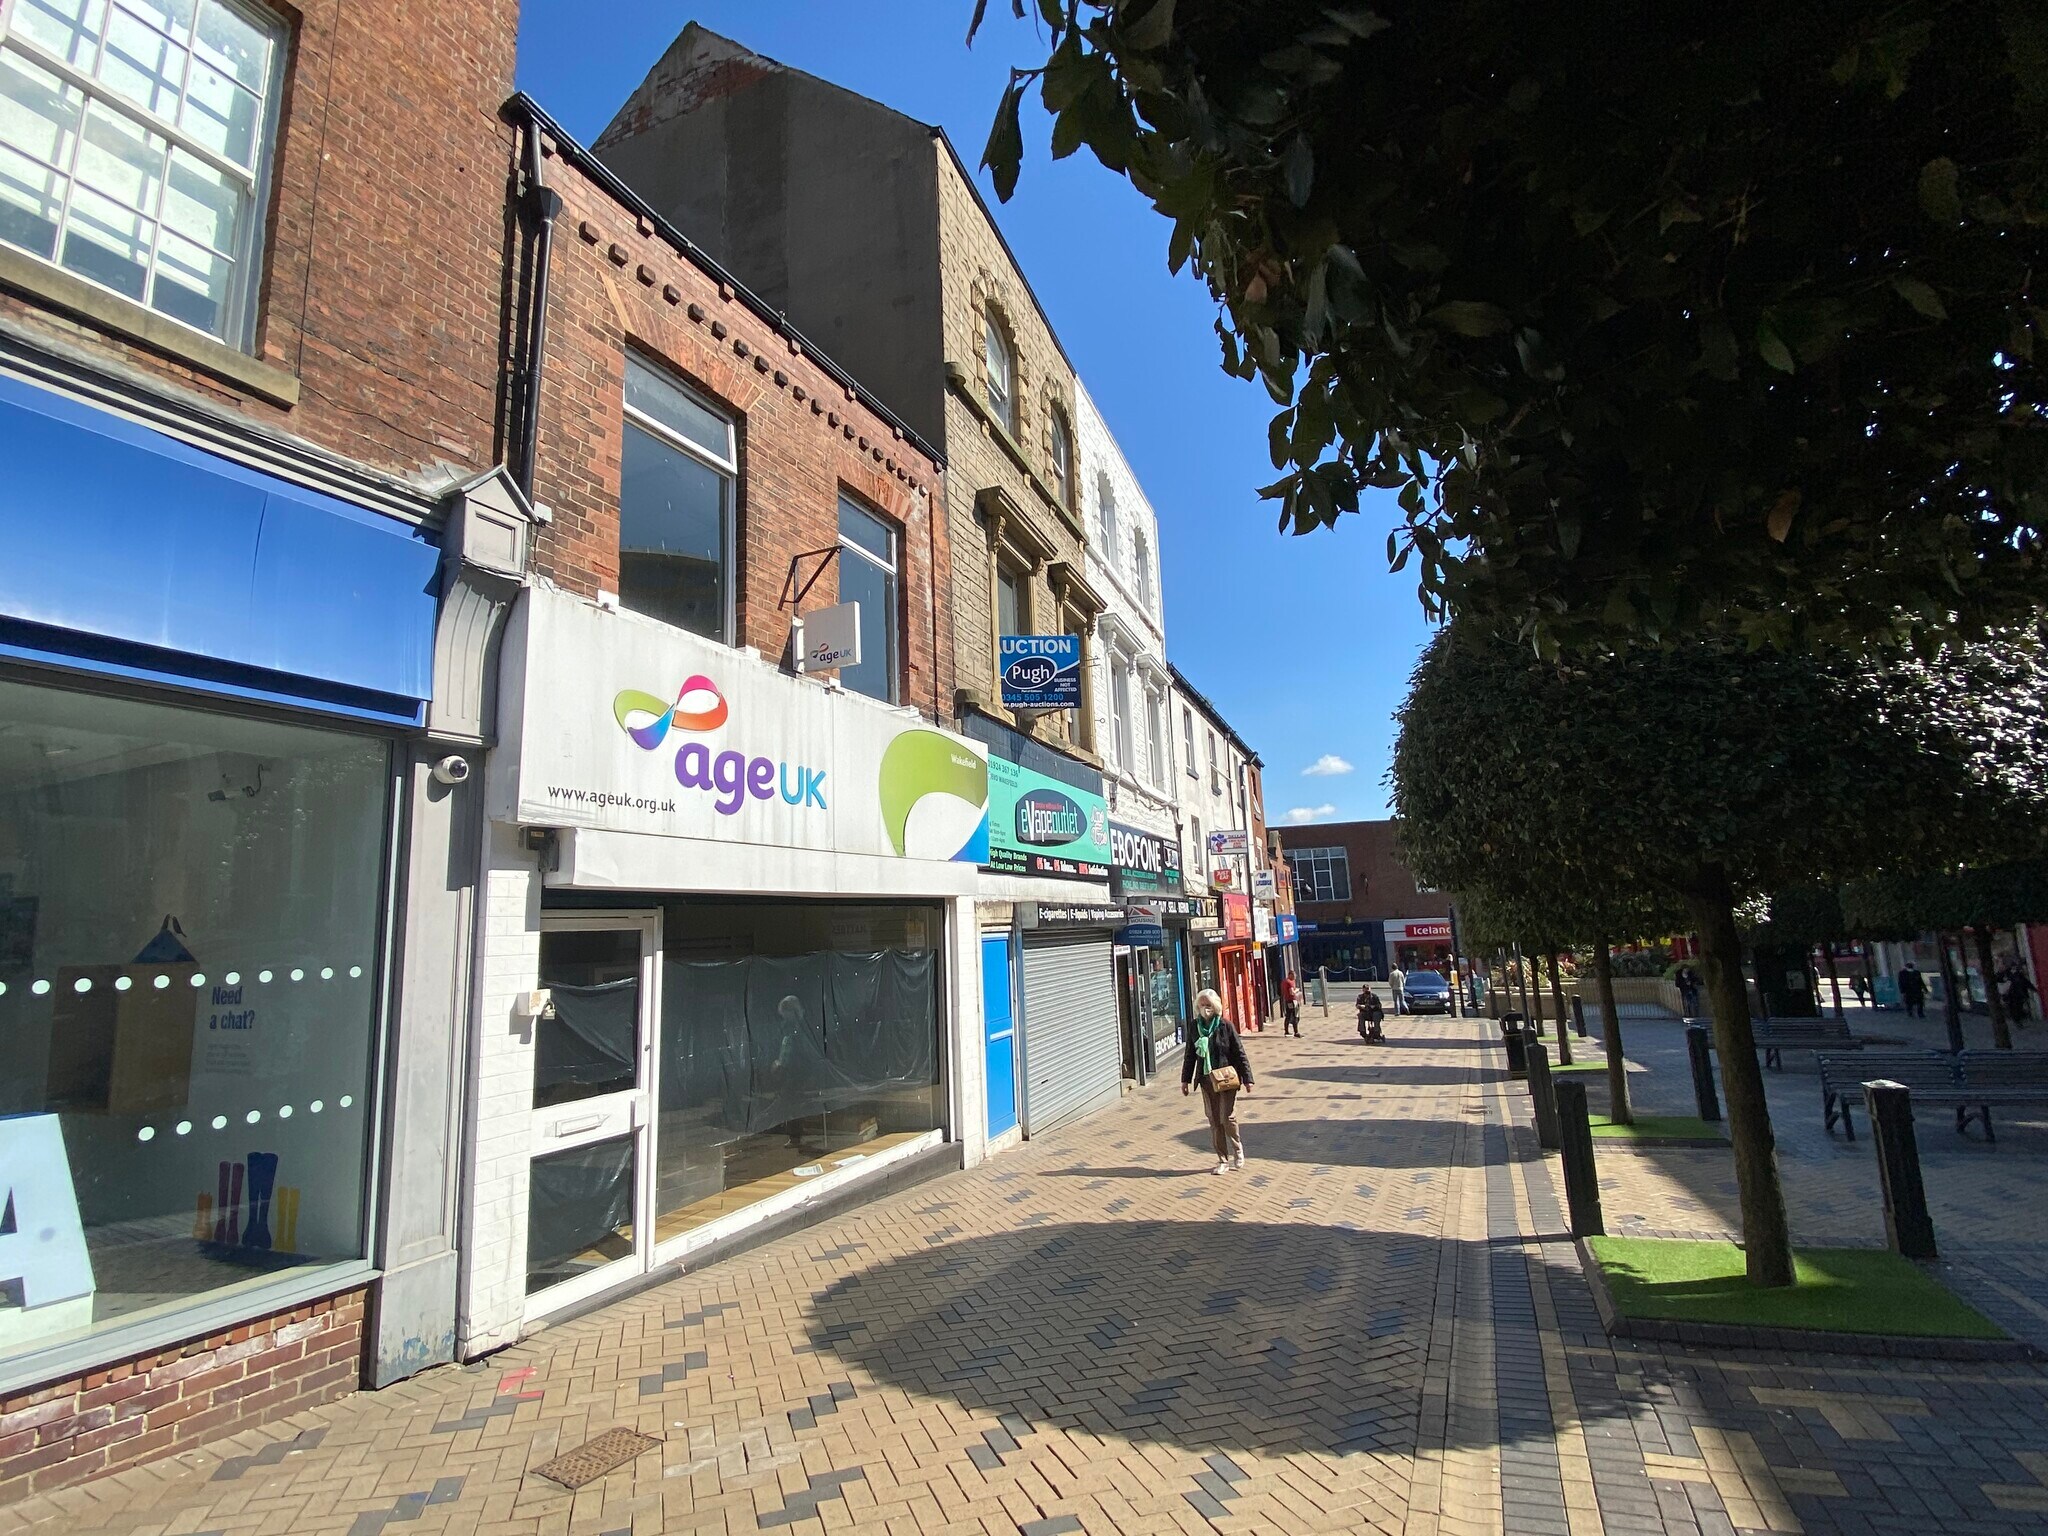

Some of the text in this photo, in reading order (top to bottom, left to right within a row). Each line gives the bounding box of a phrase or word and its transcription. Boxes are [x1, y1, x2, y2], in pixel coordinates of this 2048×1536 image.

[819, 649, 852, 663] age UK
[1000, 639, 1071, 655] UCTION
[1012, 664, 1050, 684] Pugh
[1024, 693, 1040, 701] 505
[1043, 693, 1064, 701] 1200
[951, 752, 977, 769] Wakefield
[674, 742, 828, 816] age UK
[547, 786, 676, 813] www.ageuk.org.uk
[1039, 908, 1067, 921] E-cigarettes
[212, 985, 243, 1006] Need
[209, 1009, 255, 1030] a chat?
